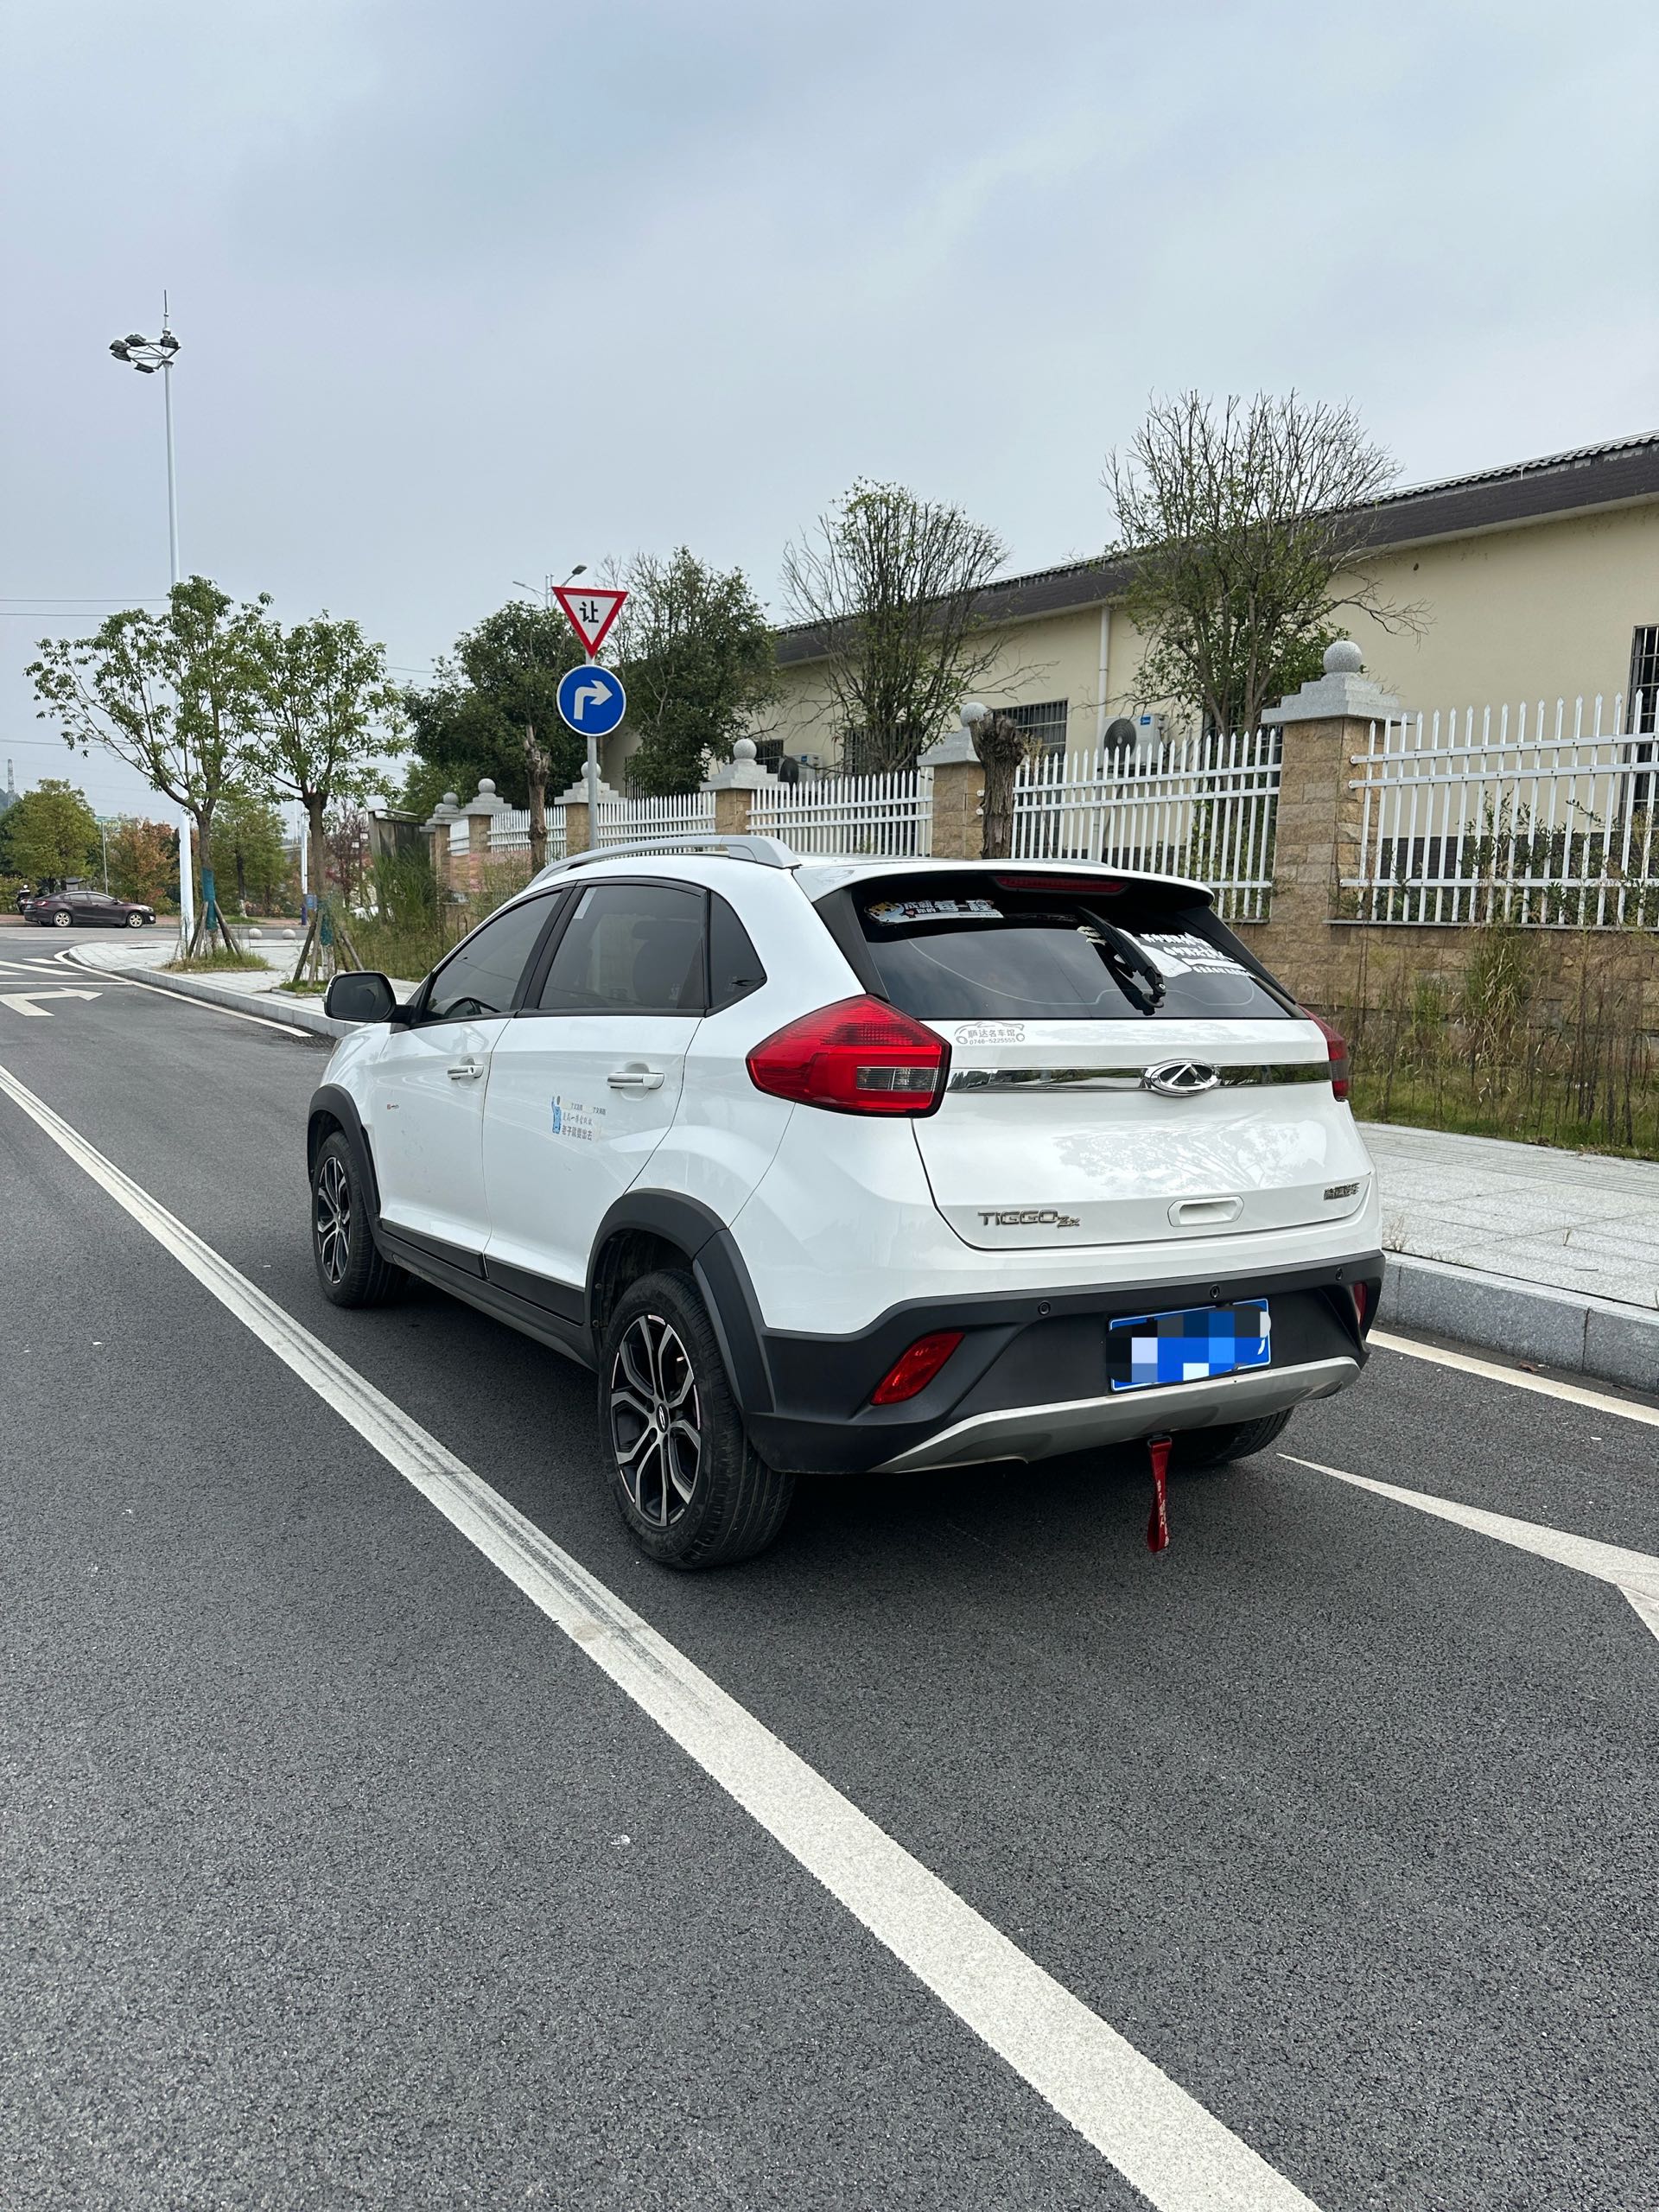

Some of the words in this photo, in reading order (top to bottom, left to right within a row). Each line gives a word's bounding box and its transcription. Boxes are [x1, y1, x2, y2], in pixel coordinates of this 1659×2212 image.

[579, 601, 600, 623] 让
[968, 1029, 1015, 1039] 顺达名车馆
